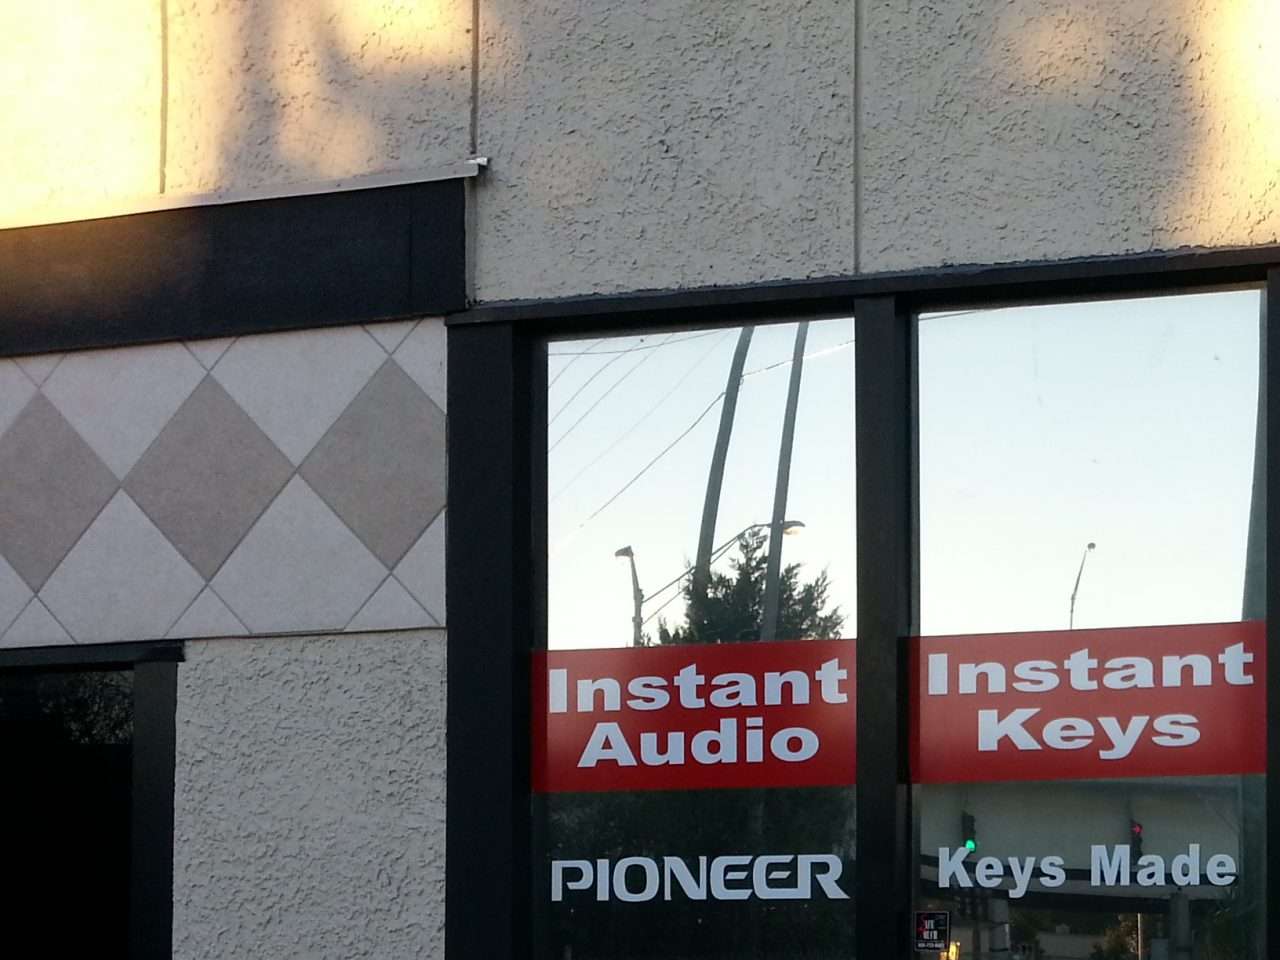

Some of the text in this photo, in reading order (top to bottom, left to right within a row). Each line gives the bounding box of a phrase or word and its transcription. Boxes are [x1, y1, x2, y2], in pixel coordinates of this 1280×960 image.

[549, 658, 848, 714] Instant
[927, 642, 1255, 695] Instant
[577, 717, 820, 768] Audio
[977, 707, 1201, 760] Keys
[551, 854, 850, 902] PIONEER
[938, 843, 1238, 898] Keys Made
